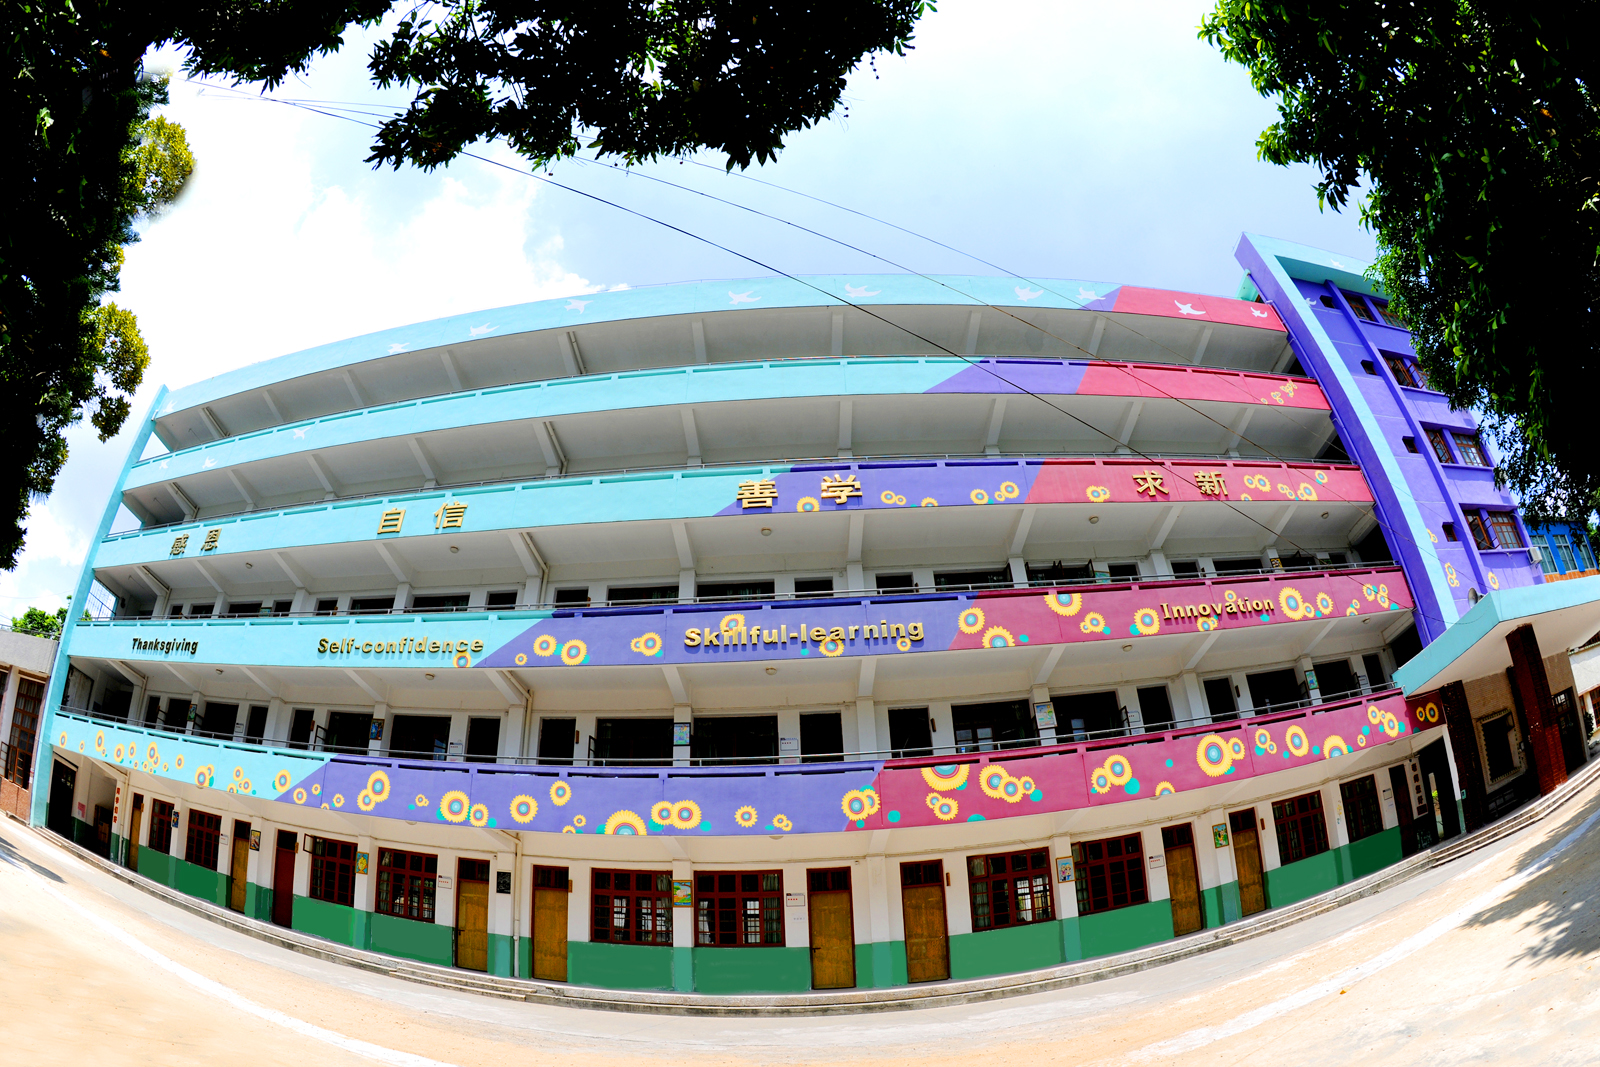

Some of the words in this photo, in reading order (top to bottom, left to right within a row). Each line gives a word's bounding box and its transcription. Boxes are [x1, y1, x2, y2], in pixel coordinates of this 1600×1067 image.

[736, 474, 863, 509] 善学
[1132, 470, 1228, 496] 求新
[377, 501, 468, 534] 自信
[169, 528, 222, 555] 感恩
[1160, 597, 1275, 620] Innovation
[132, 638, 198, 655] Thanksgiving
[317, 636, 484, 653] Self-confidence
[684, 620, 924, 647] Skillful-learning
